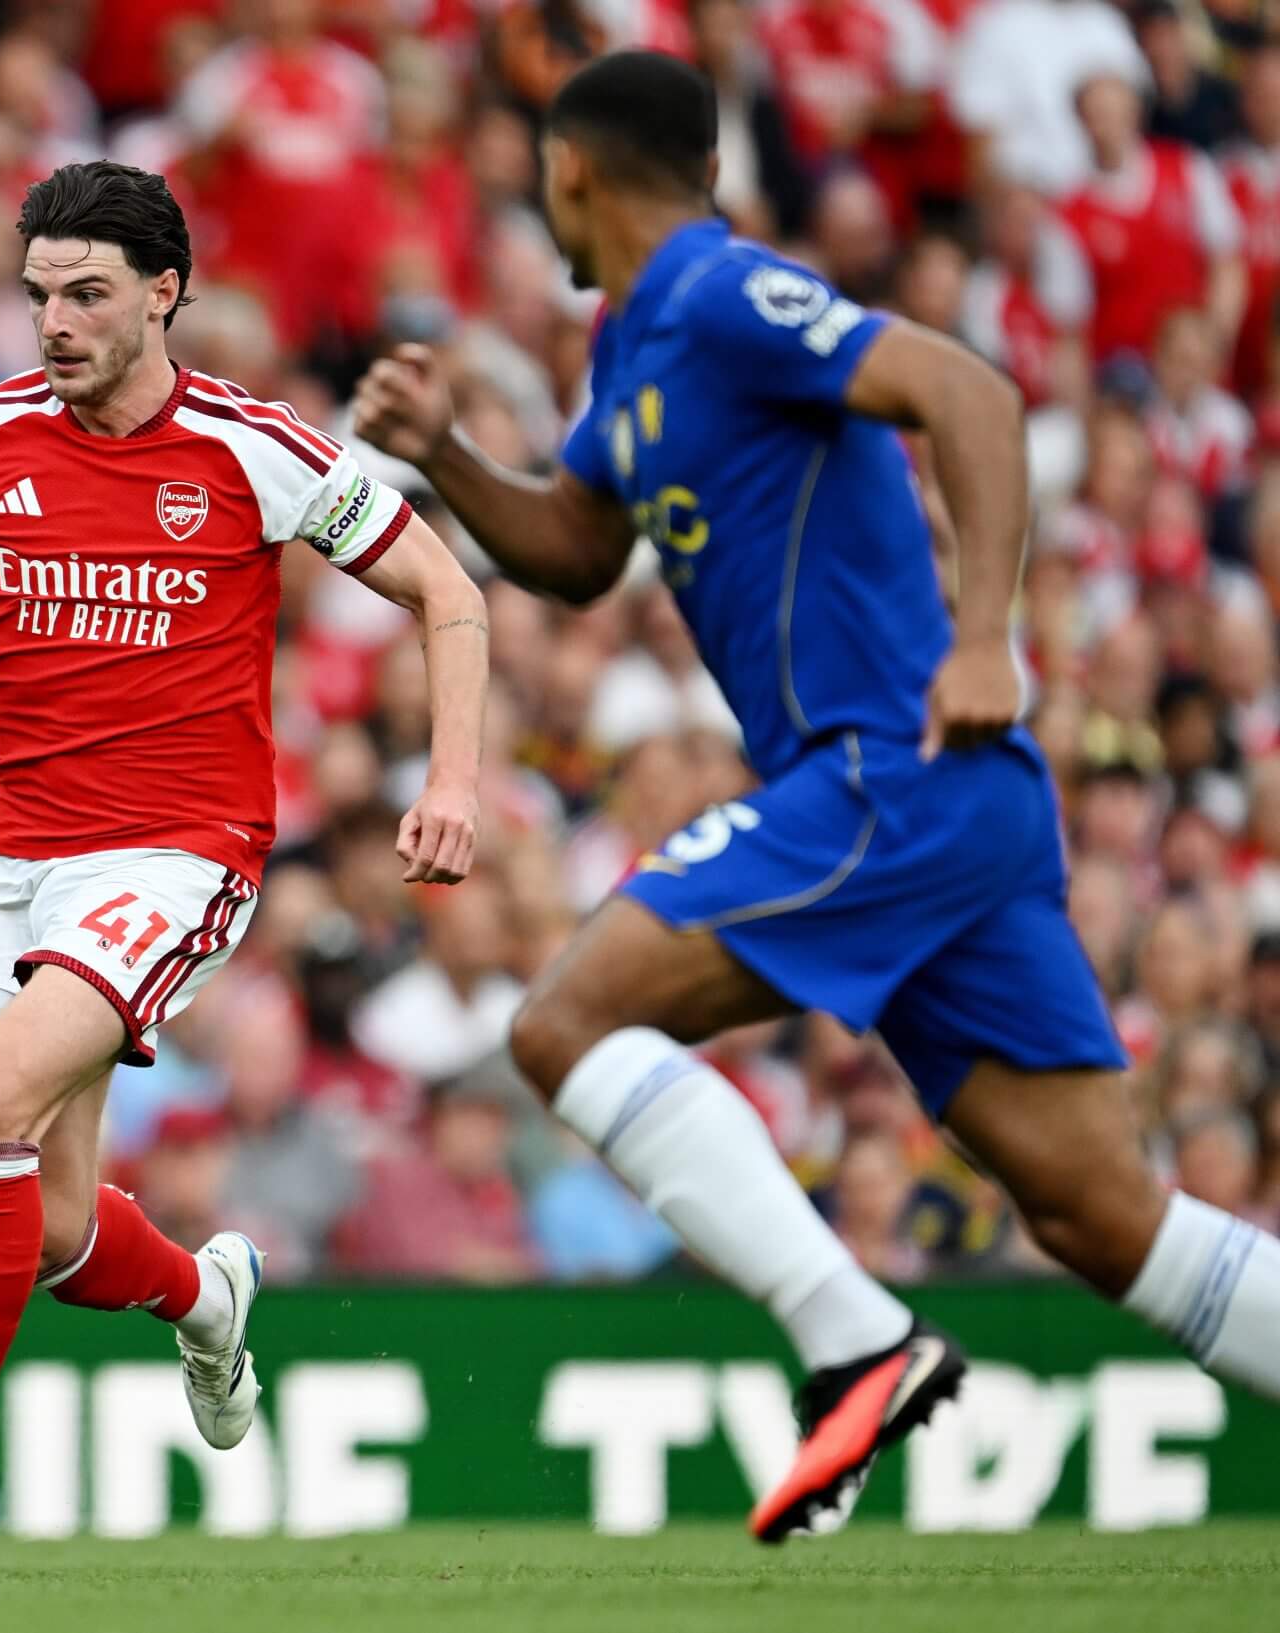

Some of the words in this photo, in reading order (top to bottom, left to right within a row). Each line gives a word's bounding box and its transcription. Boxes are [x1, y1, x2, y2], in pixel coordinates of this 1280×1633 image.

[165, 491, 201, 503] Arsenal
[327, 476, 373, 539] Captain
[17, 599, 62, 637] FLY
[69, 602, 172, 648] BETTER
[78, 891, 170, 970] 41
